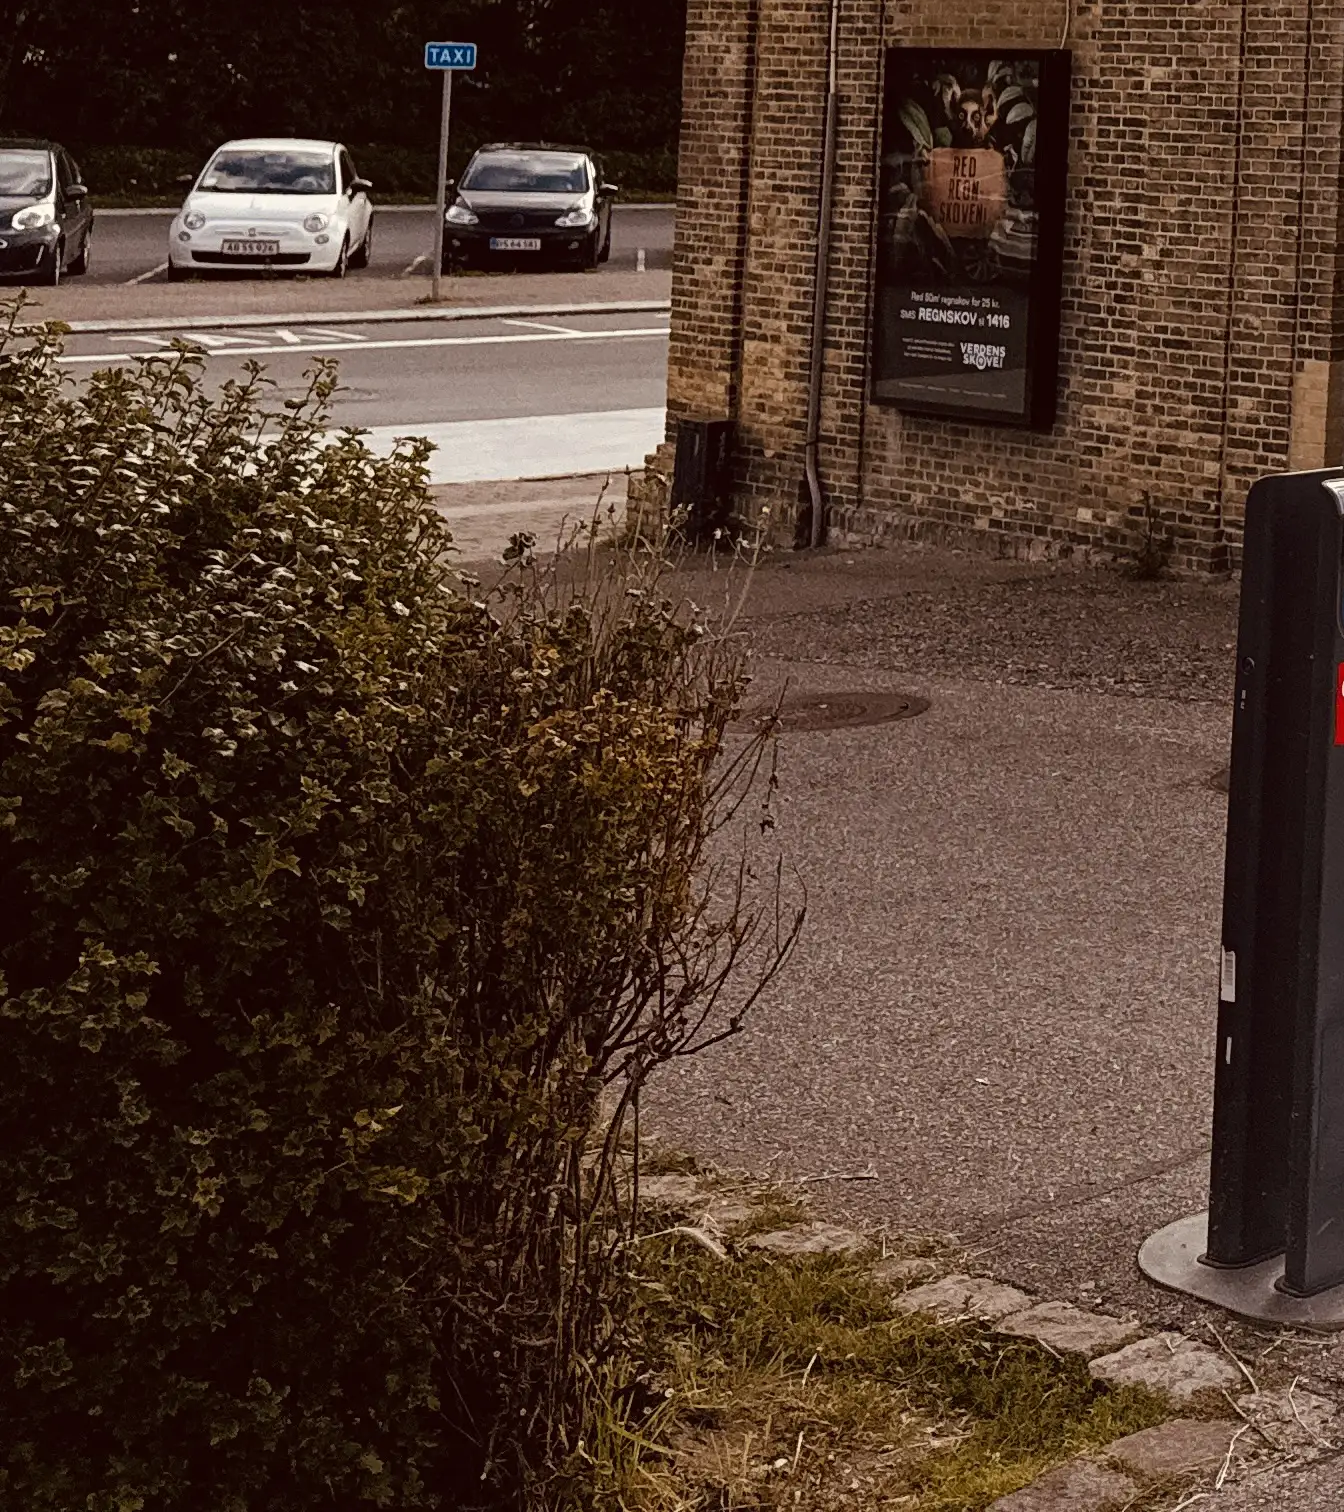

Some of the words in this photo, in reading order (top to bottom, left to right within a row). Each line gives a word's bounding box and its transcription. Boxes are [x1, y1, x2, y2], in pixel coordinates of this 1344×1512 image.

[429, 47, 471, 64] TAXI
[953, 156, 977, 177] RED
[918, 306, 978, 326] REGNSKOV
[986, 313, 1011, 329] 1416
[960, 341, 1006, 358] VERDENS
